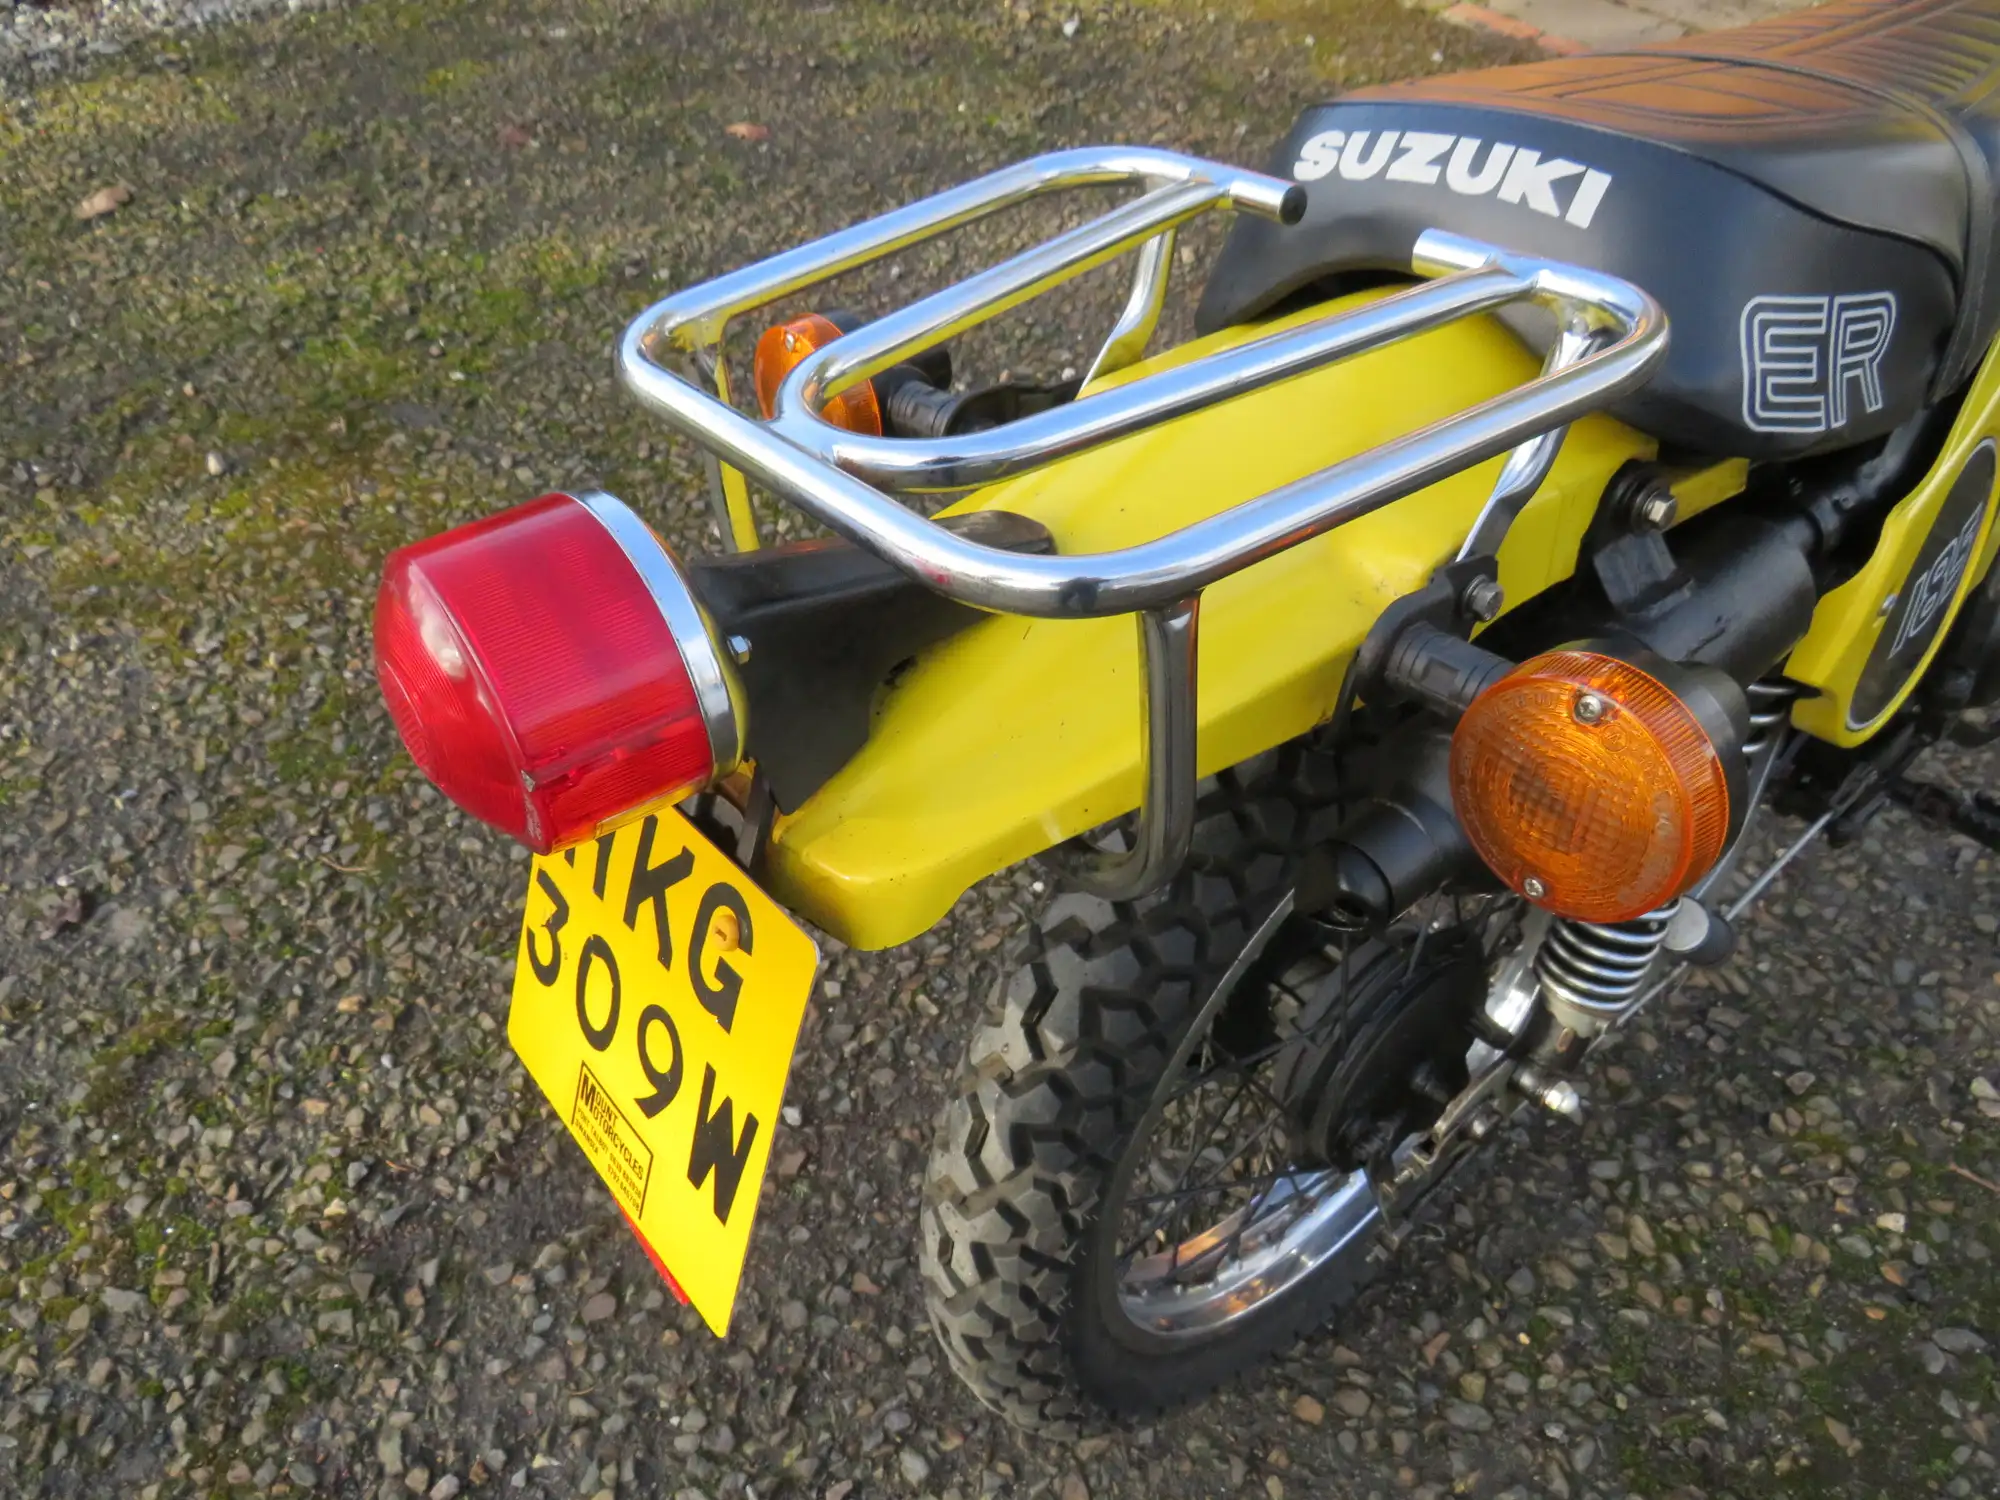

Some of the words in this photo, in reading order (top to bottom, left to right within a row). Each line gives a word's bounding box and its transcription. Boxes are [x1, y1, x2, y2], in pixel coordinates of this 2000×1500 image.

[1293, 130, 1612, 229] SUZUKI
[1740, 291, 1895, 432] ER
[527, 867, 759, 1225] 309W
[580, 1074, 618, 1127] MOUNT
